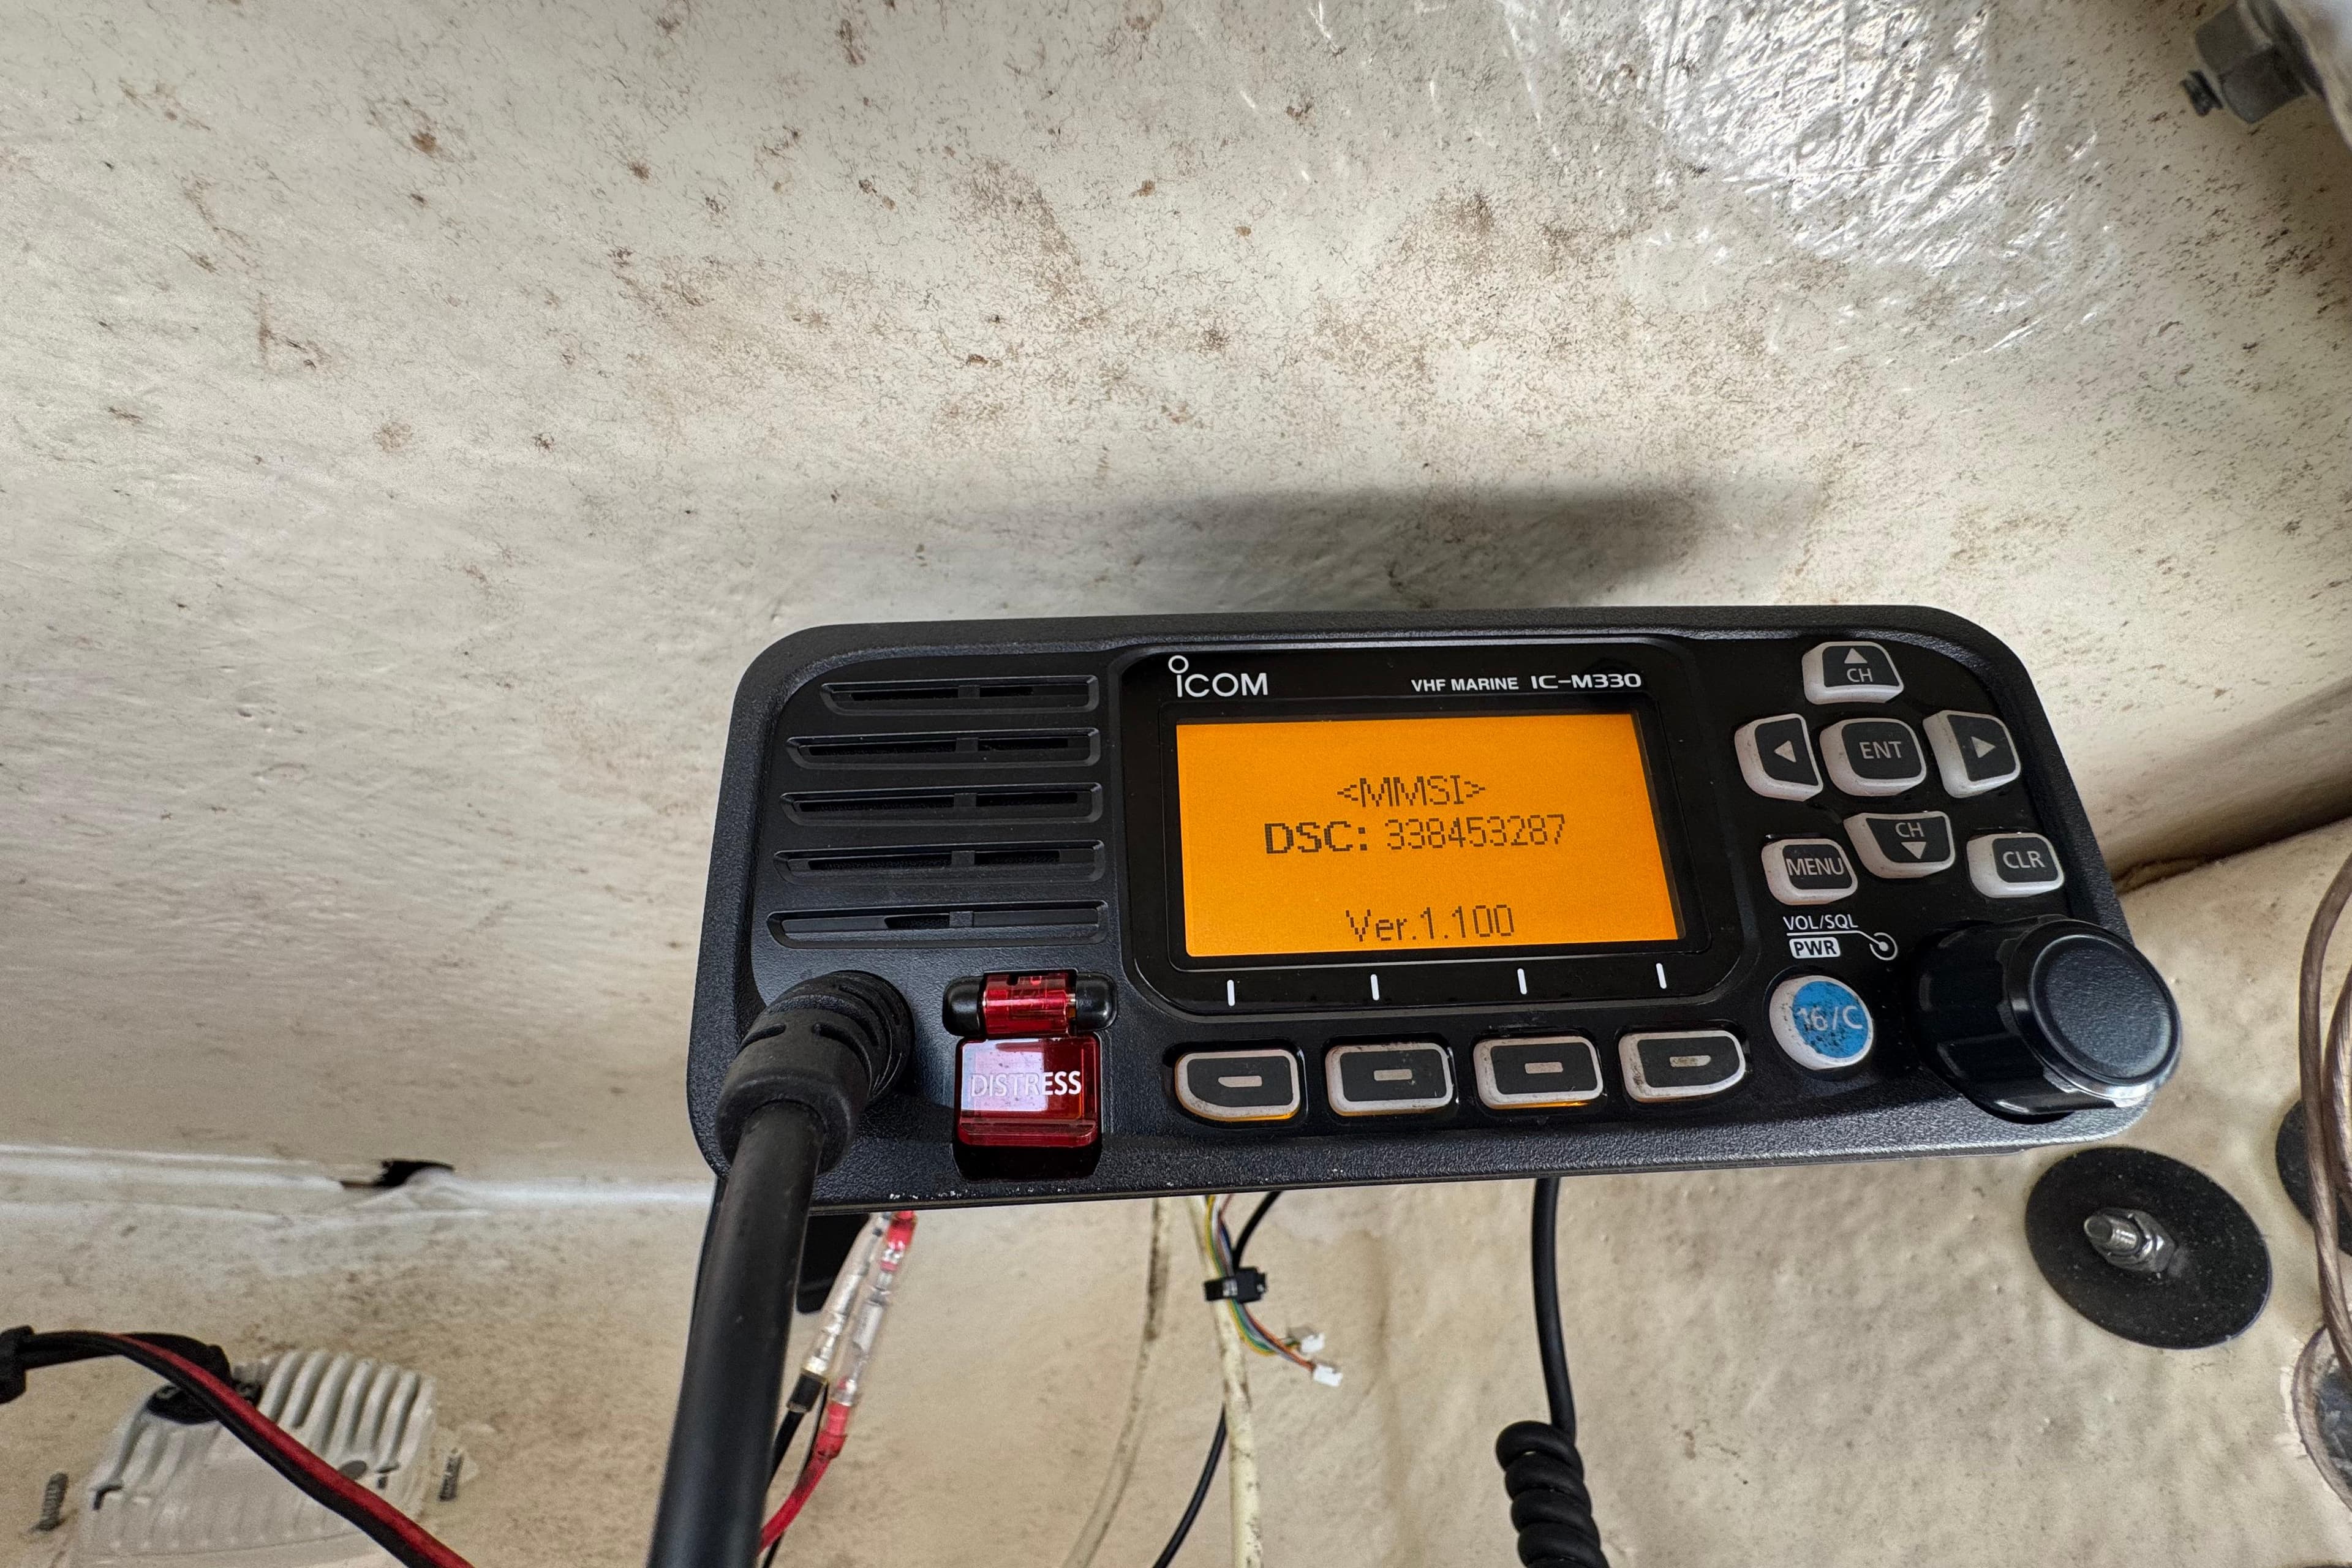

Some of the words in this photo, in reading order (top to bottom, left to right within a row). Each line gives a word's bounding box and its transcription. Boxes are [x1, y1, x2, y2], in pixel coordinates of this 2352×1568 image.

[1411, 678, 1447, 692] VHF
[1450, 676, 1518, 692] MARINE
[1530, 673, 1642, 690] IC-M330
[1846, 668, 1873, 683] CH
[1860, 741, 1902, 760] ENT
[1336, 775, 1486, 808] <MMSI>
[1264, 820, 1368, 854] DSC:
[1385, 814, 1566, 850] 338453287
[1896, 822, 1923, 838] CH
[1787, 858, 1844, 876] MENU
[2003, 851, 2045, 869] CLR
[1346, 904, 1514, 943] Ver.1.100
[1783, 915, 1858, 931] VOL/SQL
[1794, 941, 1836, 956] PWR
[1795, 1005, 1863, 1031] 16/C
[970, 1071, 1082, 1098] DISTRESS
